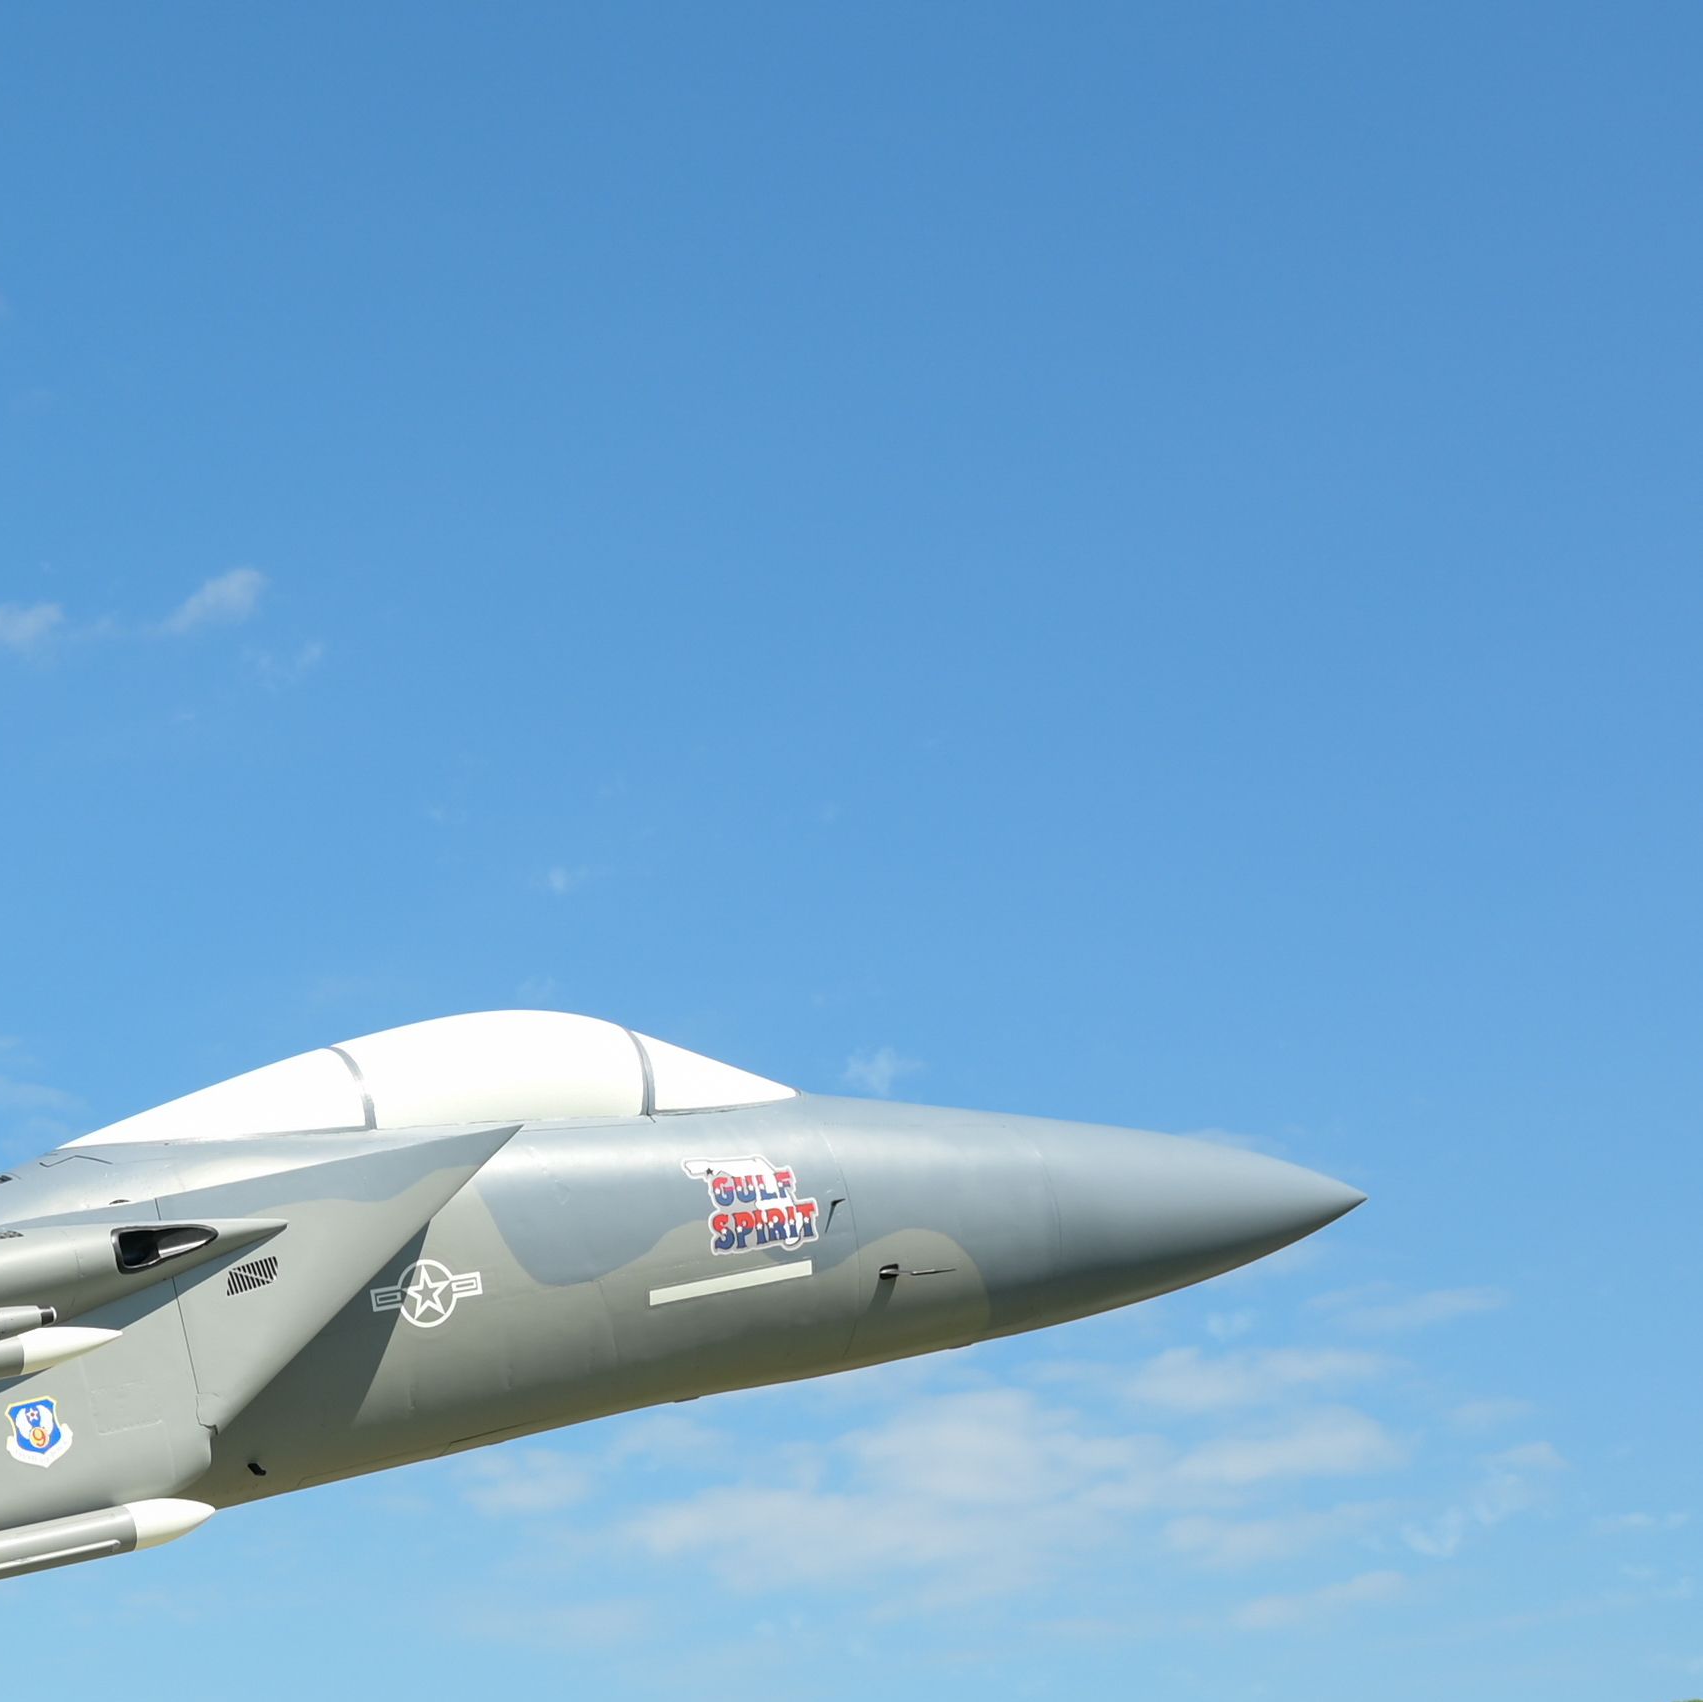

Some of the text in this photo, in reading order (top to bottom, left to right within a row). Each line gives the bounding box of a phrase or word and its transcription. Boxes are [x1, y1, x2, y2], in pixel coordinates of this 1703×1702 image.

[712, 1170, 792, 1207] GULF
[712, 1202, 816, 1250] SPIRIT
[31, 1427, 47, 1448] 9
